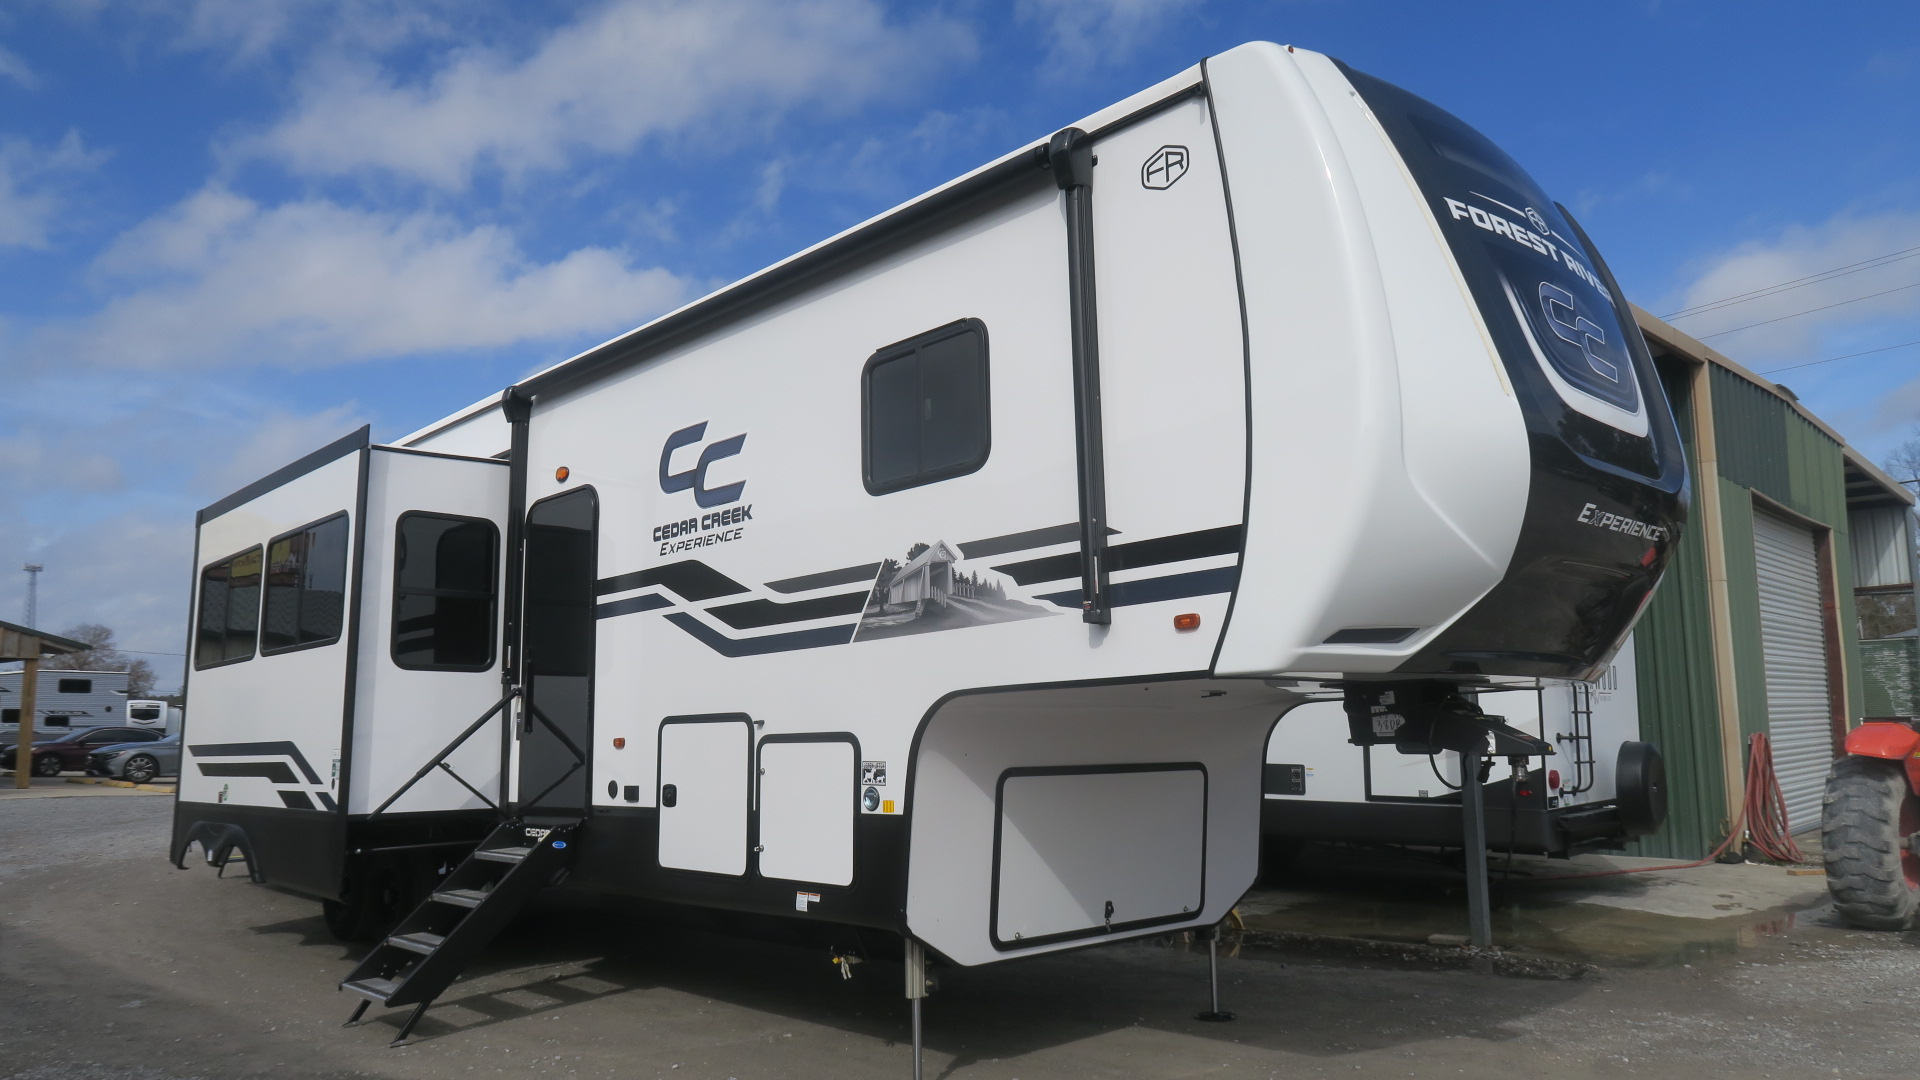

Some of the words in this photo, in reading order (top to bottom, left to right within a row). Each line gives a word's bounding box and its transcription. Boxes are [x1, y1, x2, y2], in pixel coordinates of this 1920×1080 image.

[1443, 197, 1558, 262] FOREST
[1539, 282, 1618, 383] CC
[658, 420, 748, 509] CC
[653, 517, 698, 543] CEDAR
[701, 504, 753, 531] CREEK
